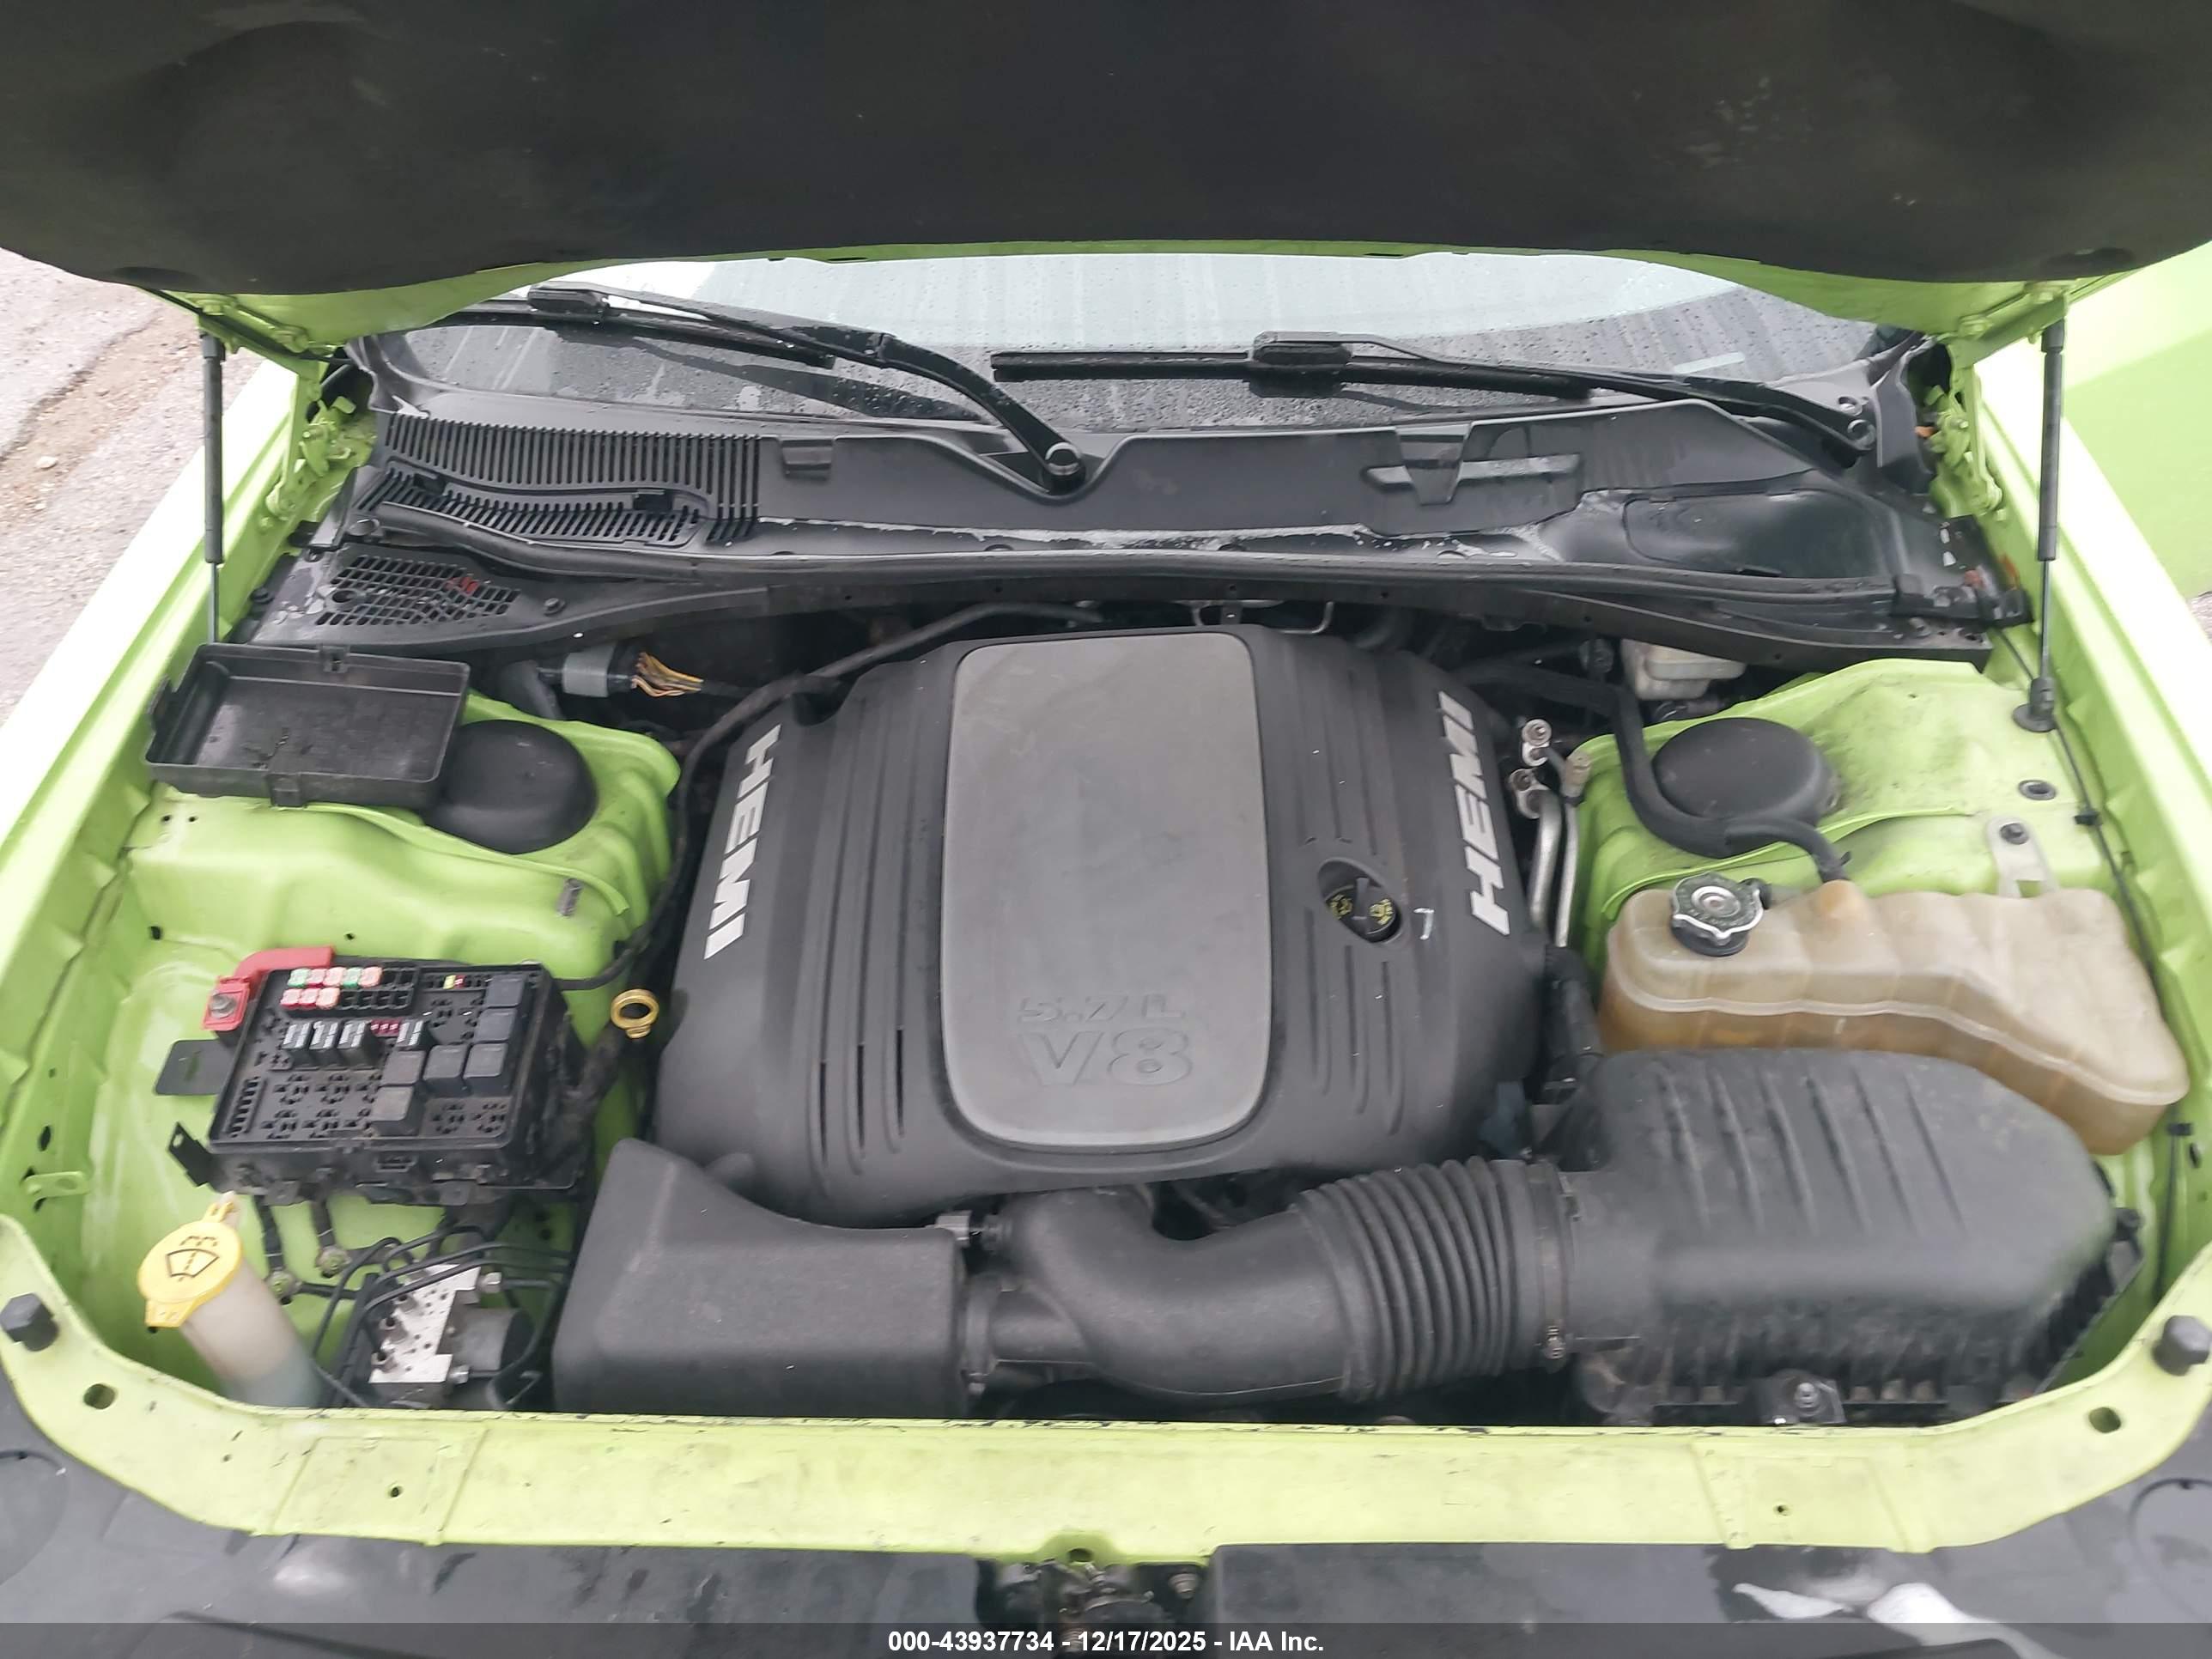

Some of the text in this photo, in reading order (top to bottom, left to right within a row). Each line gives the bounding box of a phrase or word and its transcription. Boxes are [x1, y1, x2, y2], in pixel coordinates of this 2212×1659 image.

[703, 723, 781, 960] HEMI
[1438, 690, 1510, 936] HEMI
[1017, 994, 1187, 1024] 5.7L
[1018, 1026, 1193, 1087] V8
